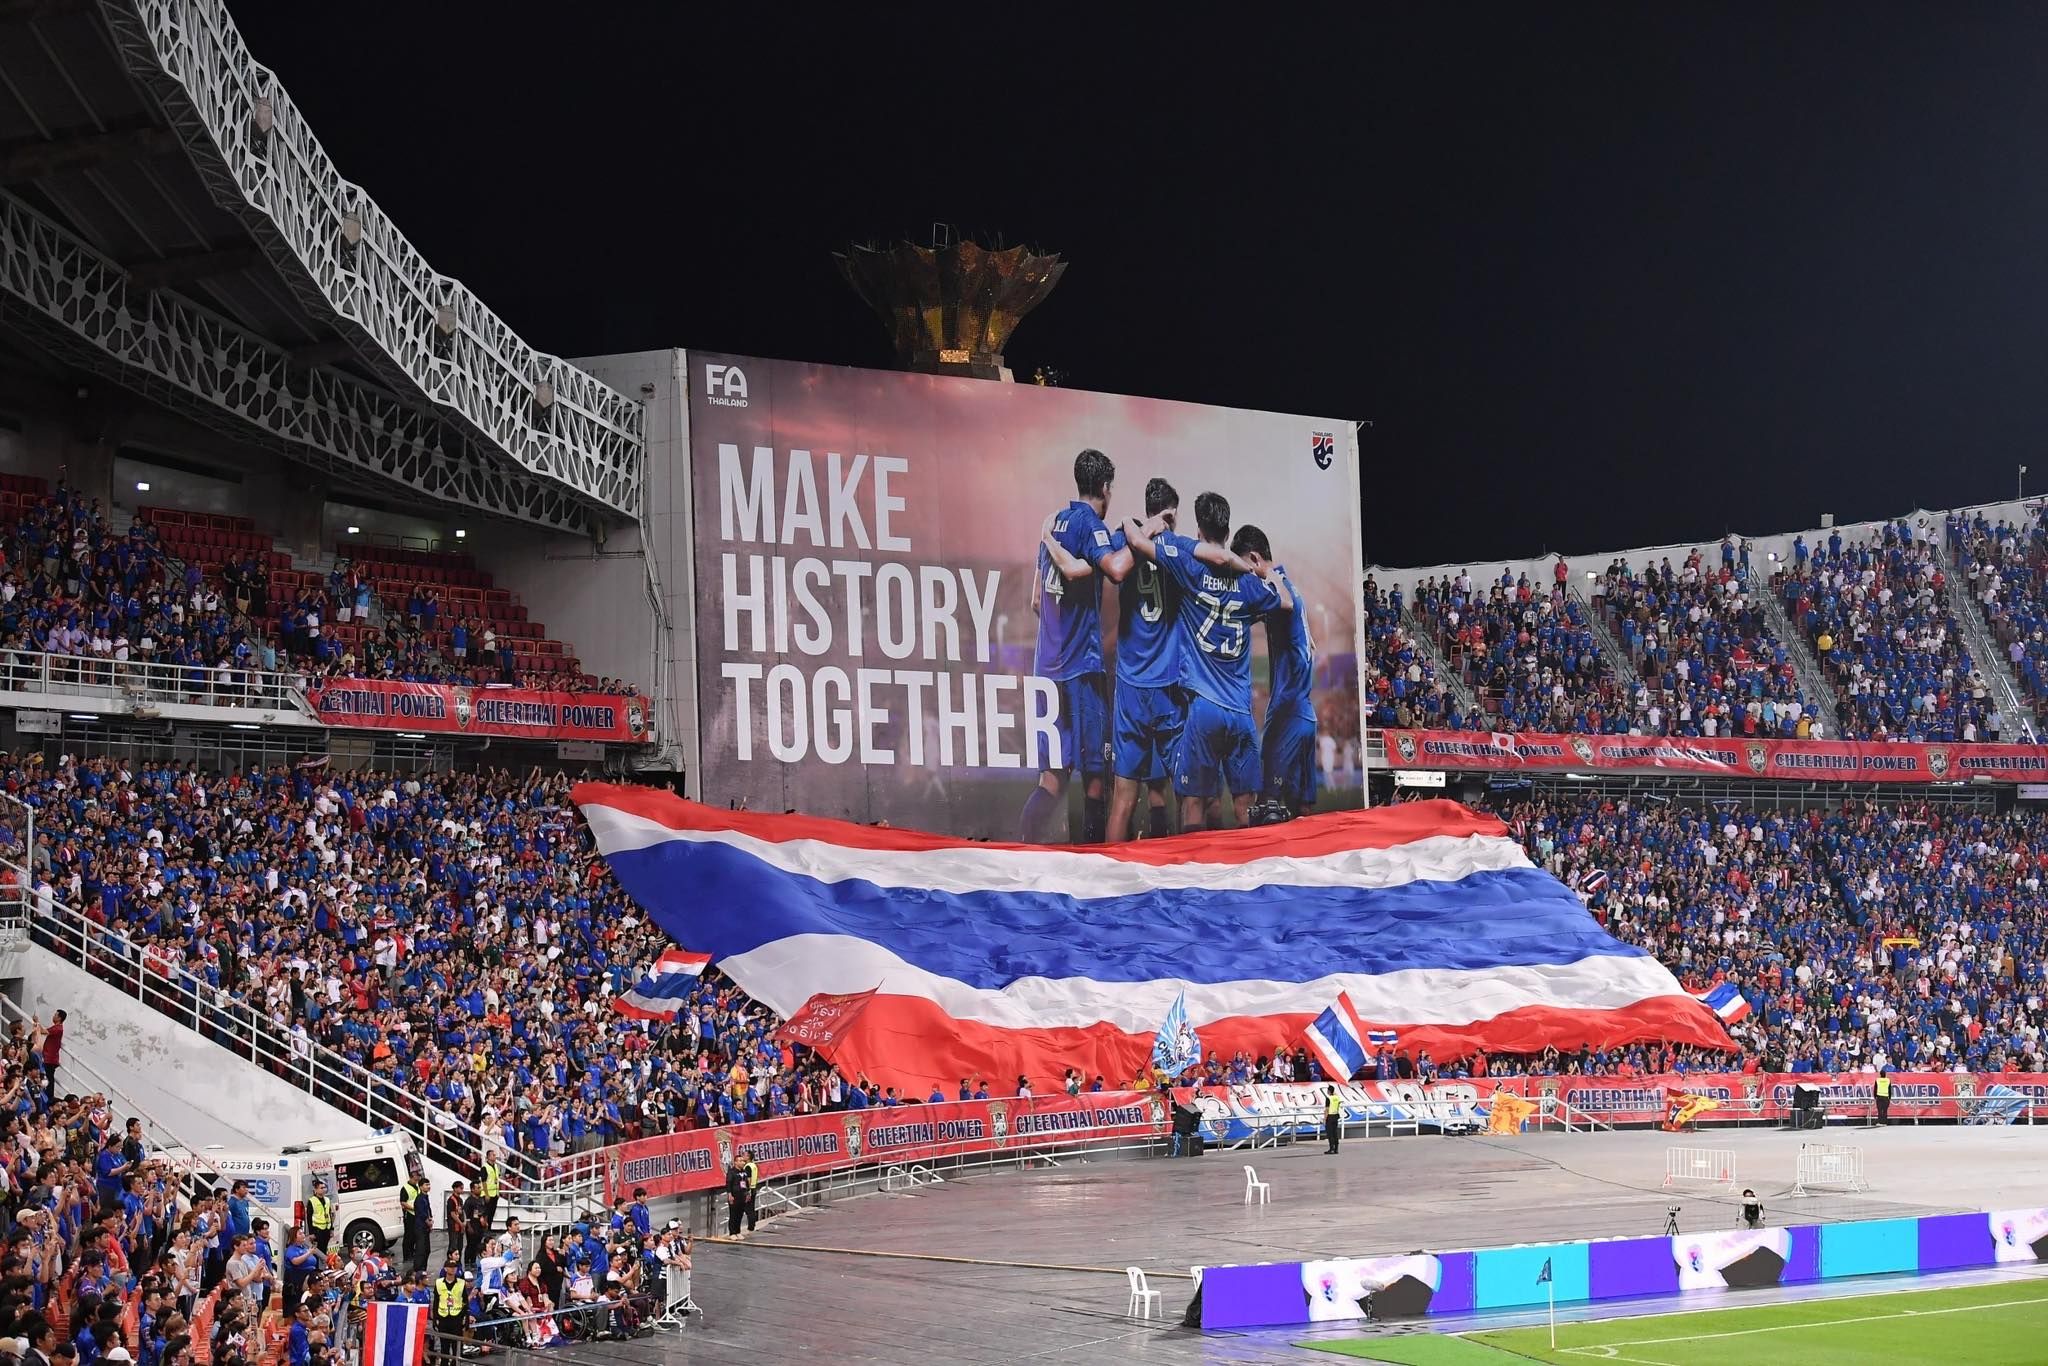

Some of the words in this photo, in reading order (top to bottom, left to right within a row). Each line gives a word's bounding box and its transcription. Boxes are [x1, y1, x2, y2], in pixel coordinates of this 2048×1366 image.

[706, 364, 748, 398] FA
[707, 396, 748, 408] THAILAND
[718, 443, 912, 553] MAKE
[1137, 560, 1164, 623] 9
[722, 553, 1001, 663] HISTORY
[1194, 592, 1245, 658] 25
[391, 692, 447, 719] POWER
[475, 699, 558, 727] CHEERTHAI
[561, 705, 615, 729] POWER
[721, 662, 1063, 770] TOGETHER
[1775, 753, 1858, 769] CHEERTHAI
[1863, 755, 1918, 771] POWER
[1959, 756, 2047, 771] CHEERTHAI
[1566, 1087, 1664, 1111] CHEERTHAI
[1889, 1083, 1941, 1106] OWER
[867, 1121, 934, 1149] CHEERTHAI
[938, 1118, 985, 1140] POWER
[1015, 1110, 1094, 1135] CHEERTHAI
[1096, 1105, 1145, 1127] POWER
[797, 1132, 839, 1157] POWER
[220, 1161, 229, 1170] 0
[230, 1161, 254, 1171] 2378
[255, 1162, 277, 1171] 9191
[623, 1154, 673, 1185] CHEERTHAI
[675, 1148, 713, 1174] POWER
